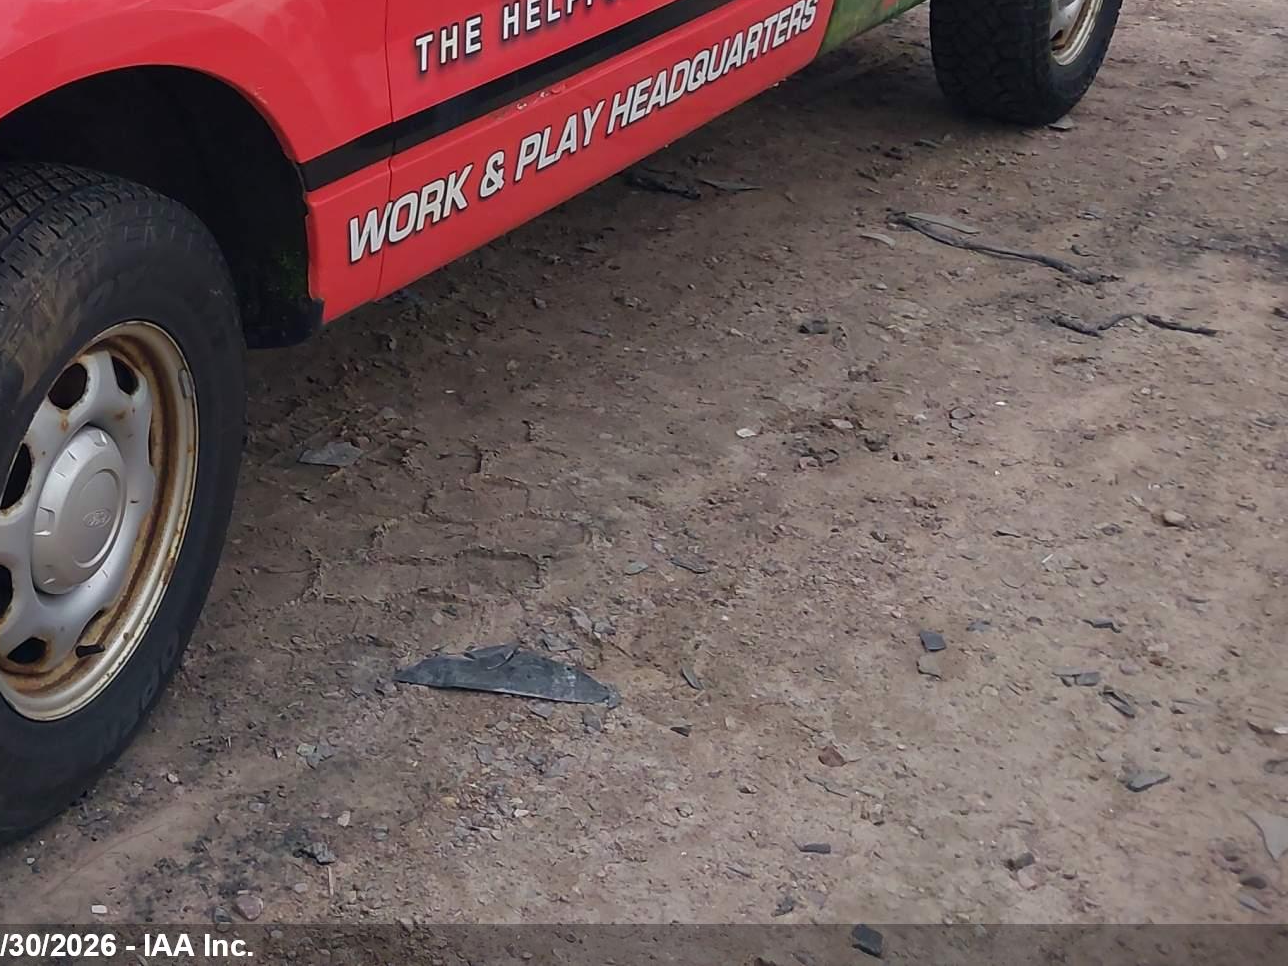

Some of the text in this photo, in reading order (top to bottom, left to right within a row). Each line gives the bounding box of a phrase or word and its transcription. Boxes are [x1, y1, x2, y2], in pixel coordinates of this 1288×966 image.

[415, 16, 481, 72] THE
[348, 163, 474, 263] WORK
[479, 151, 505, 198] &
[513, 100, 604, 182] PLAY
